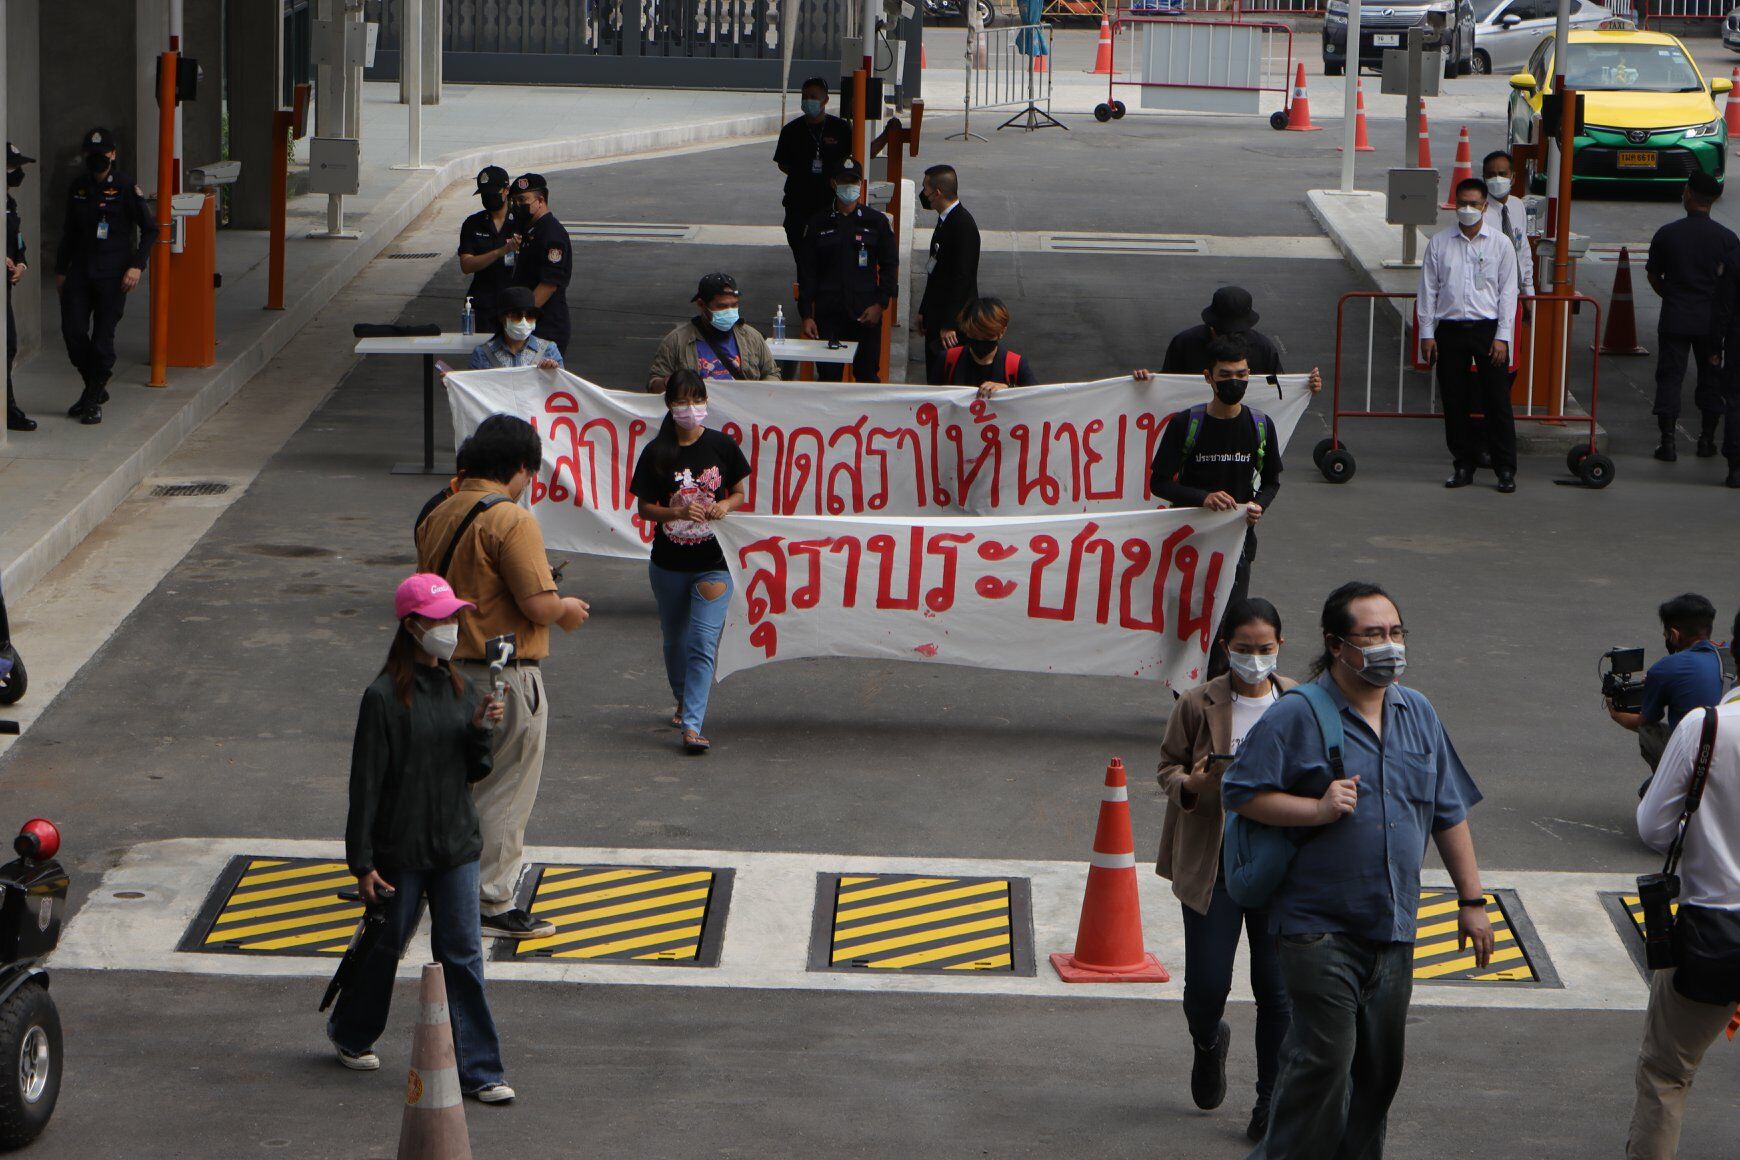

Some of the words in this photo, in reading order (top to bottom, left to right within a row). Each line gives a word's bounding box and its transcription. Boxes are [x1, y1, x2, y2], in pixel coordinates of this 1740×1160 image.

[1609, 21, 1625, 29] TAXI
[738, 521, 1224, 658] สุราประชาชน
[1701, 744, 1710, 764] EOS
